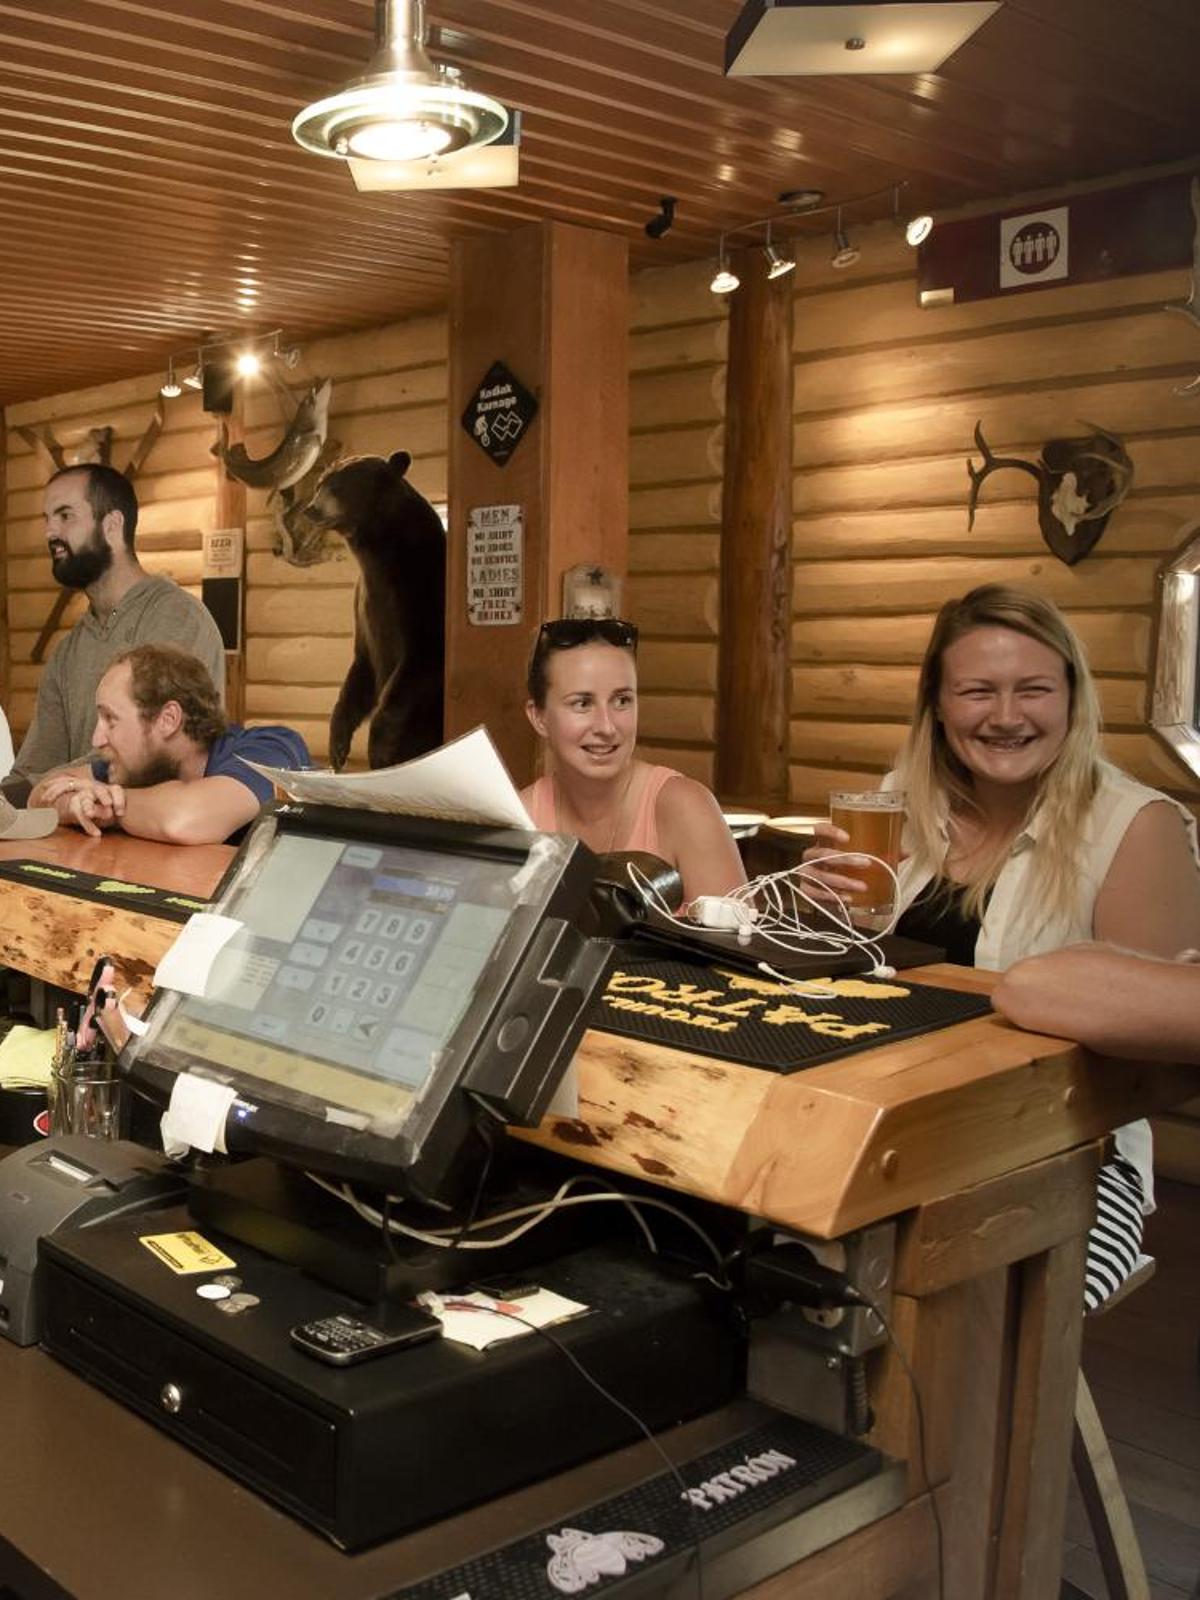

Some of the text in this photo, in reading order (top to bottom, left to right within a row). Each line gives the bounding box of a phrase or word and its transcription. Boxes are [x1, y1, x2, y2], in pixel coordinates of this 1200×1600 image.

[480, 508, 510, 524] MEN
[471, 567, 520, 583] LADIES
[363, 912, 425, 940] 7 8 9
[345, 945, 409, 972] 4 5 6
[352, 981, 367, 998] 2
[377, 986, 393, 1004] 3
[311, 1005, 325, 1023] 0
